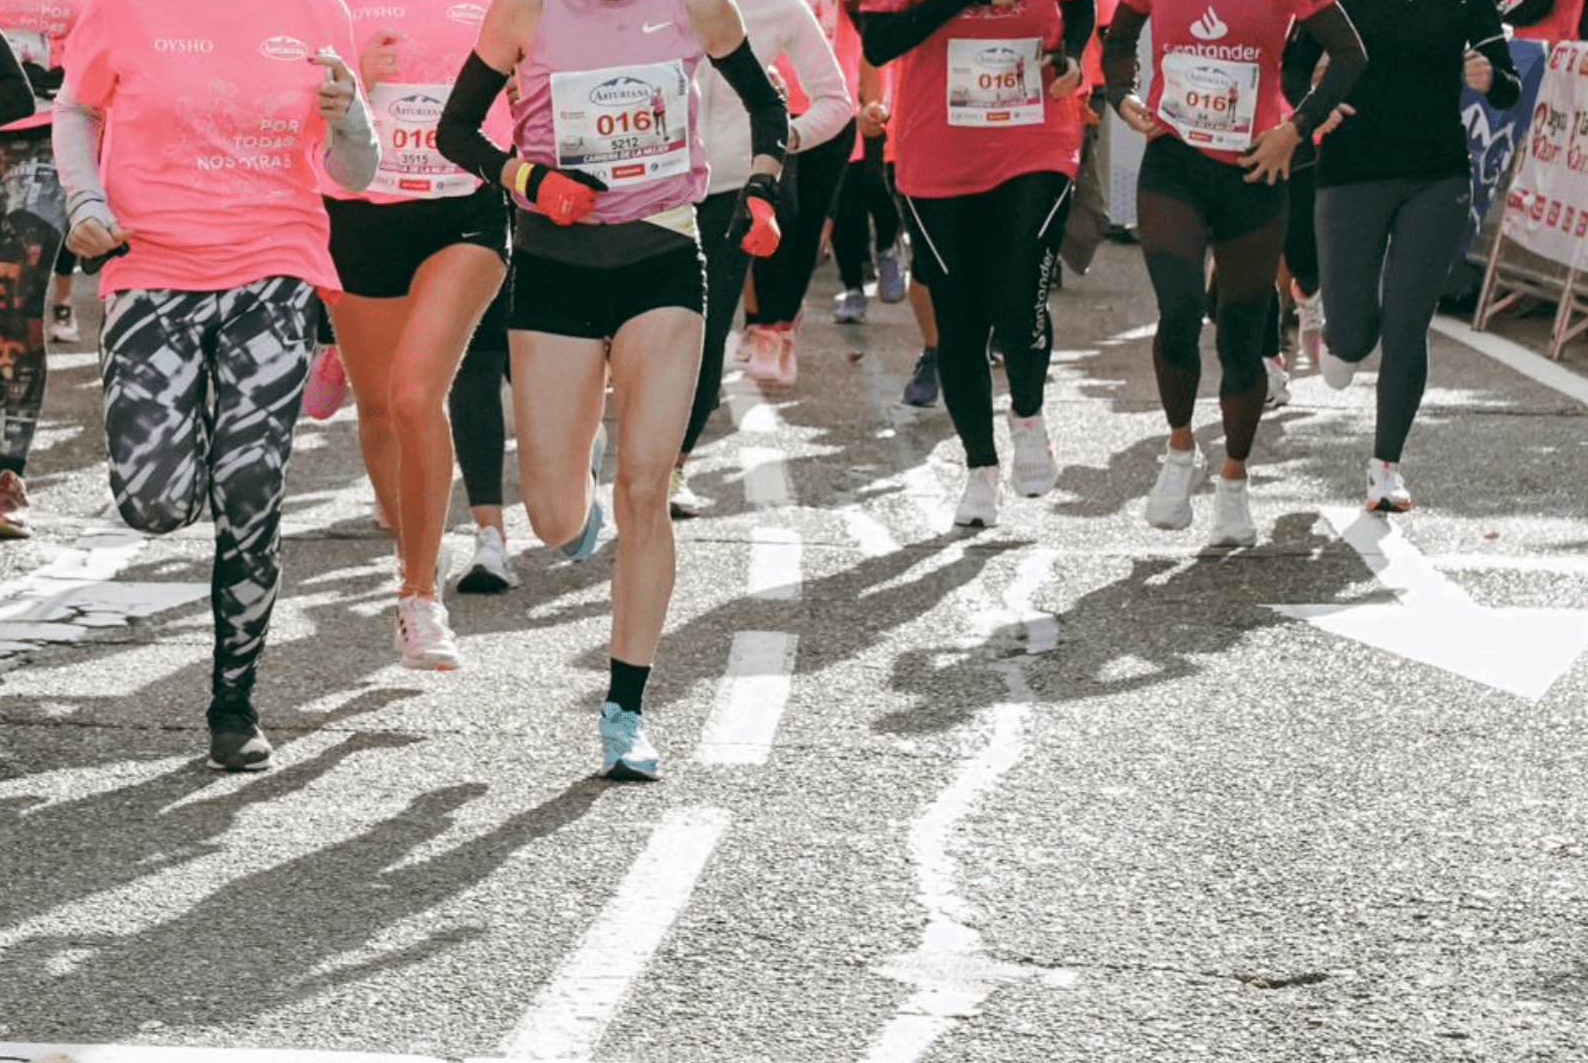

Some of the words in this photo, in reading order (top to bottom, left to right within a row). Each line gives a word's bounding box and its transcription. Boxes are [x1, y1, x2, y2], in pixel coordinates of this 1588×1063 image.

[154, 37, 214, 54] OYSHO
[978, 72, 1016, 89] 016
[1185, 91, 1227, 112] 016
[259, 119, 300, 134] POR
[596, 110, 652, 136] 016
[1033, 246, 1054, 337] Santander
